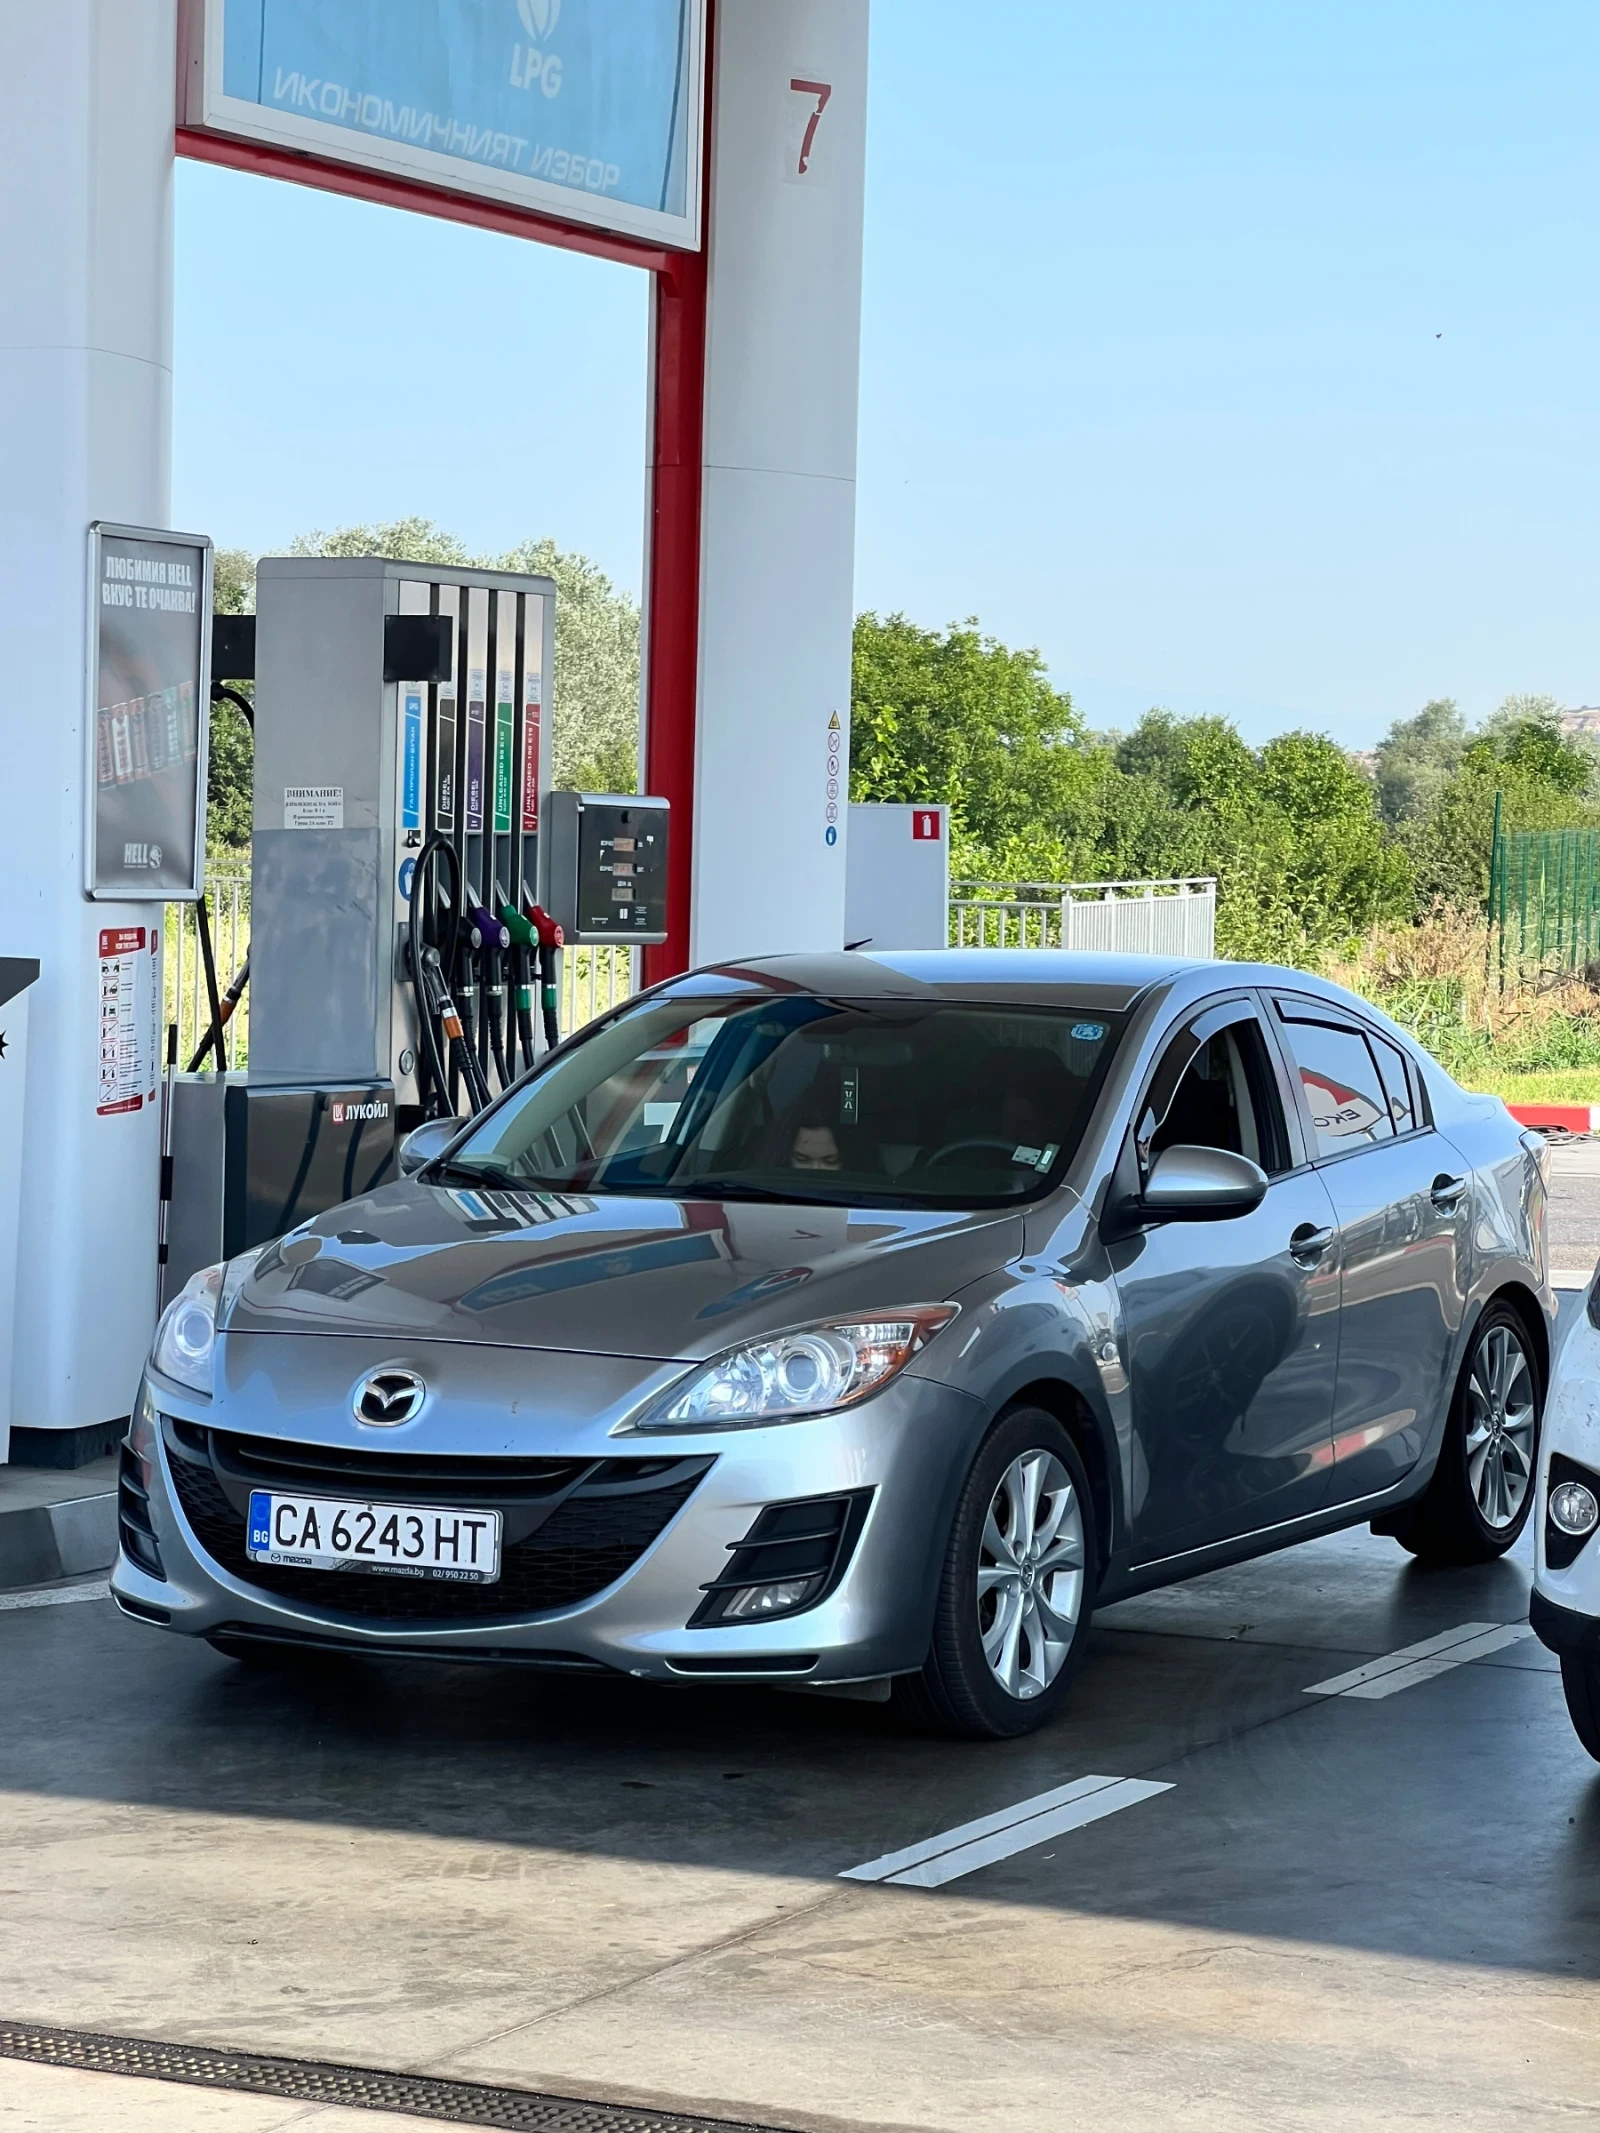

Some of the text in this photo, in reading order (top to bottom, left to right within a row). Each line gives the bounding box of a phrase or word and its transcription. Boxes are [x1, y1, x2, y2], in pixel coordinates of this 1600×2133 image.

[509, 43, 563, 100] LPG
[273, 66, 621, 192] ИКОНОМИЧНИЯТ ИЗБОР
[790, 78, 832, 175] 7
[106, 556, 192, 587] ЛЮБИМИЯ HELL
[102, 583, 196, 613] ВКУС ТЕ ОЧАКВА!
[286, 789, 342, 798] ВНИМАНИЕ!
[124, 843, 149, 864] HELL
[345, 1100, 389, 1120] ЛУКОЙЛ
[253, 1529, 269, 1544] BG
[275, 1504, 487, 1564] CA 6243 HT
[372, 1565, 425, 1577] www.mazda.bg
[469, 1572, 479, 1581] 50
